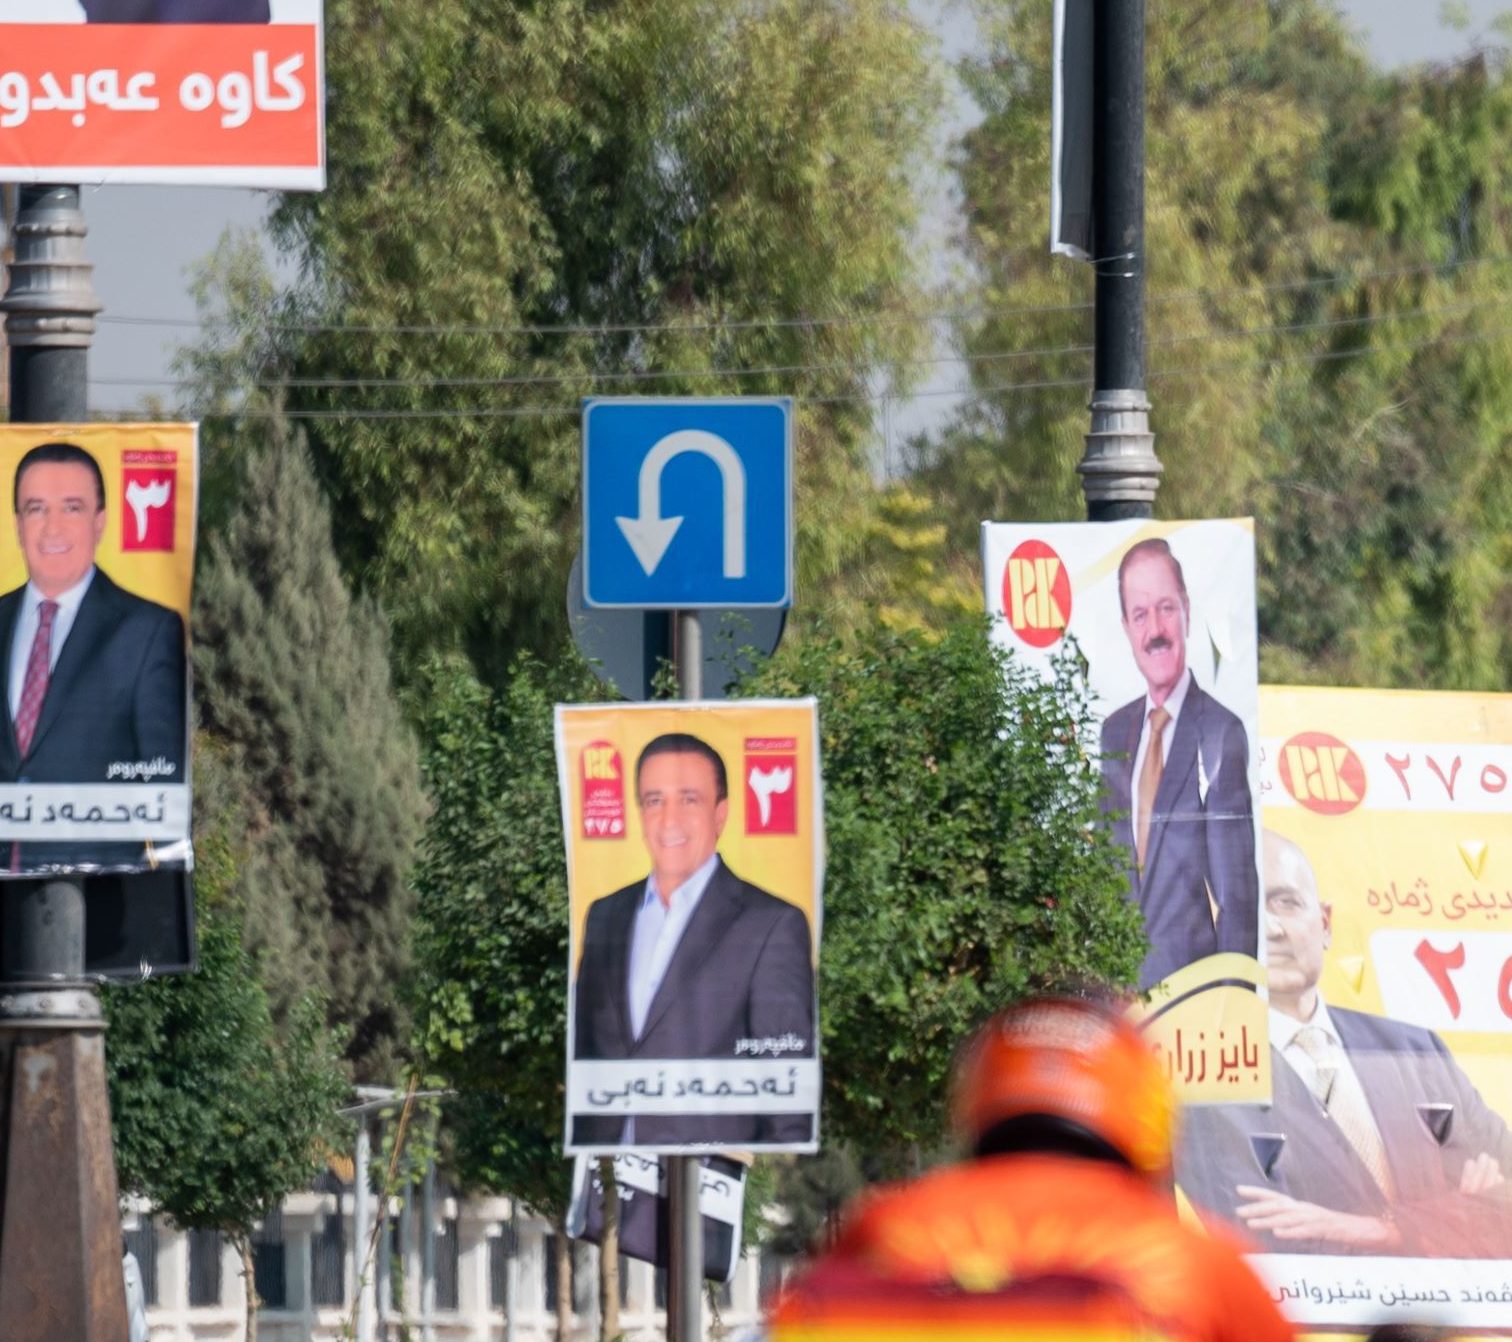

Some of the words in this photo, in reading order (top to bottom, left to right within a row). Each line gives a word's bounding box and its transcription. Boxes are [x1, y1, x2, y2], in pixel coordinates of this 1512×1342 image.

[180, 50, 308, 129] کاوە
[125, 479, 172, 543] ٣
[747, 765, 794, 828] ٣
[1384, 752, 1509, 802] ٢٧٥
[1366, 877, 1434, 917] ژمارە
[1152, 1028, 1206, 1084] زرار
[1216, 1024, 1259, 1083] بایز
